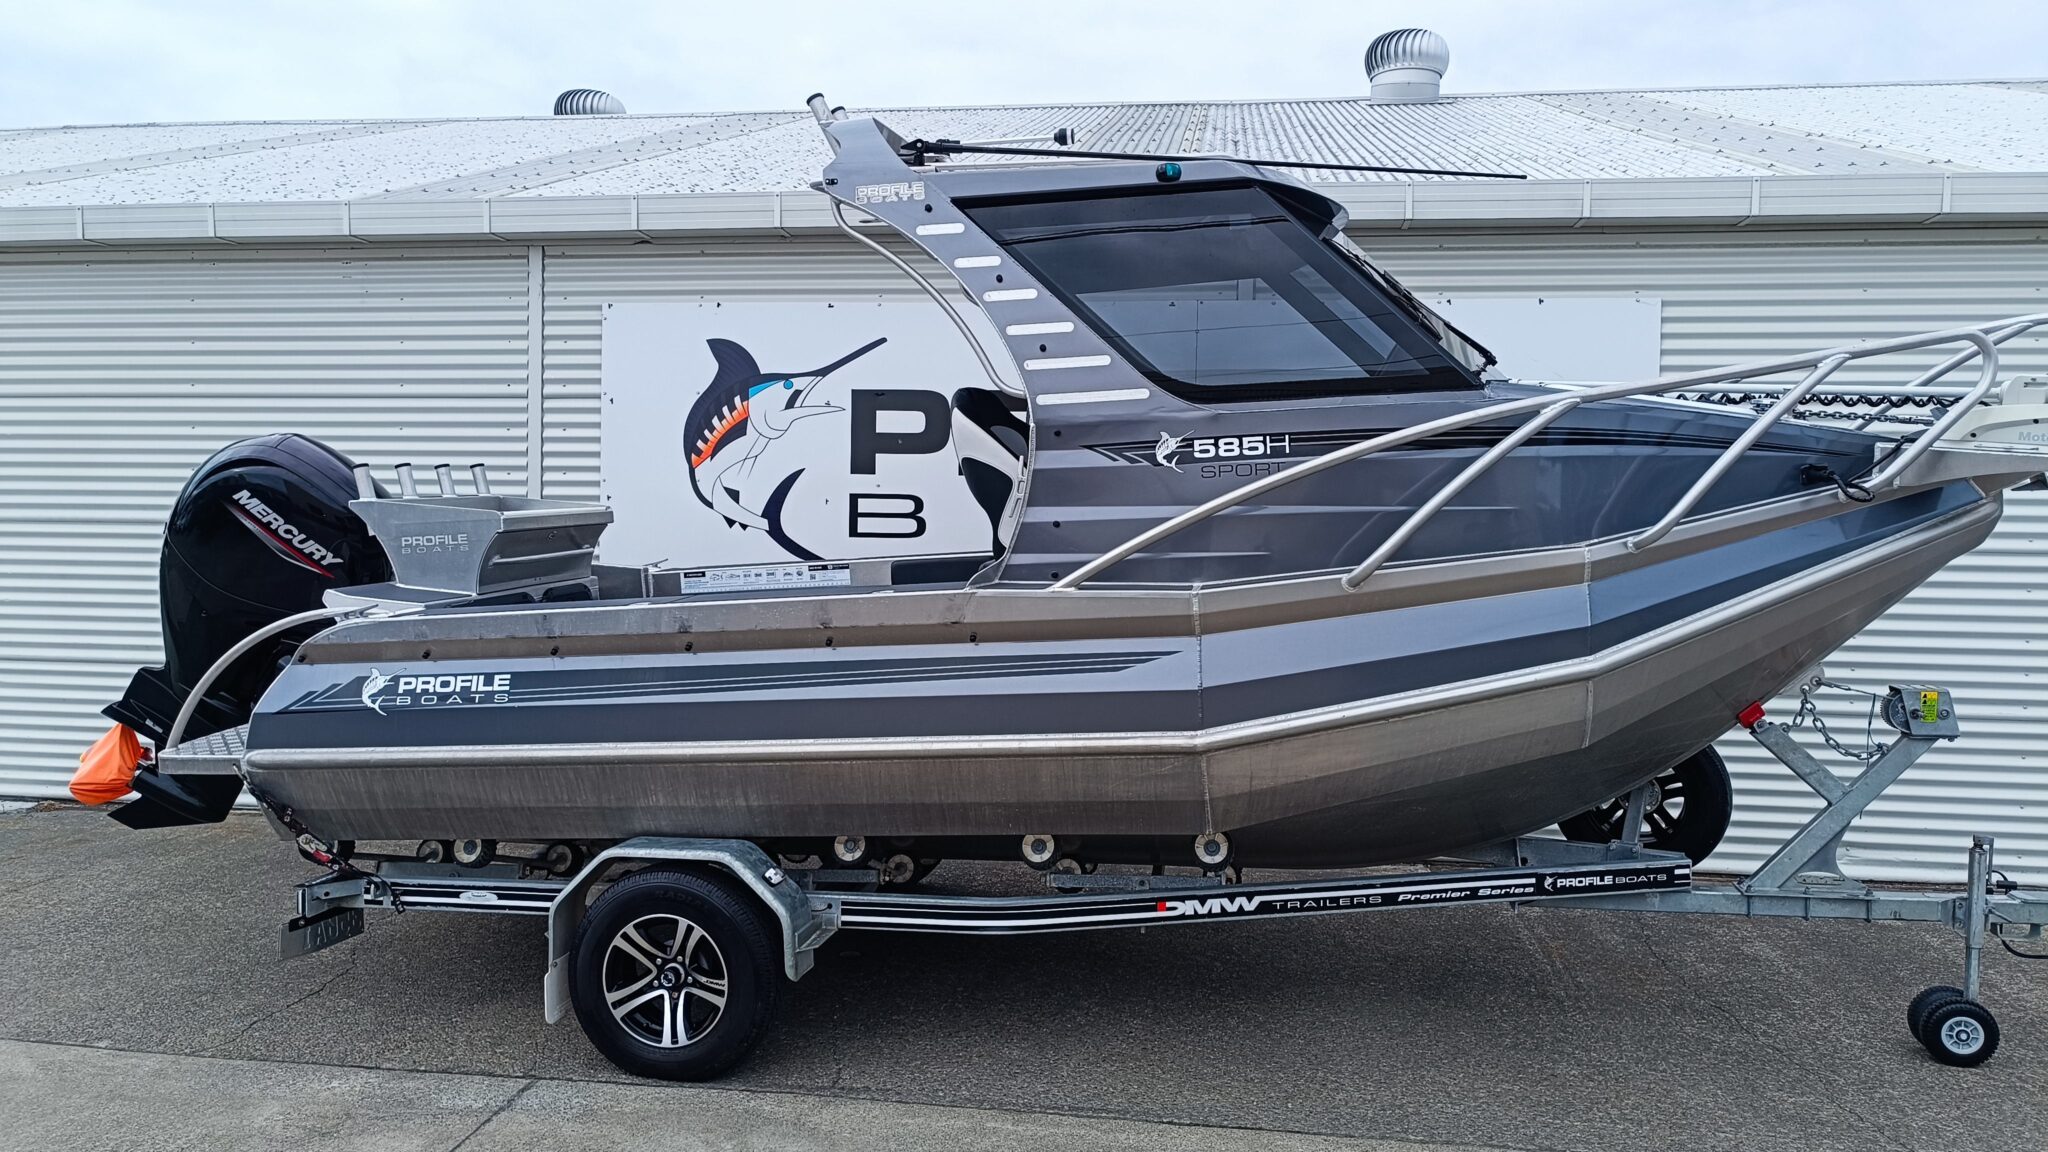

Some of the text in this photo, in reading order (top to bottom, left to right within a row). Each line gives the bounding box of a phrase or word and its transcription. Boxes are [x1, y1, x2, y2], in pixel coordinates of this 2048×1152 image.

[856, 181, 924, 197] PROFILE
[856, 191, 925, 204] BOATS
[1194, 435, 1289, 458] 585H
[1201, 462, 1286, 479] SPORT
[232, 490, 344, 566] MERCURY
[401, 534, 468, 547] PROFILE
[402, 545, 469, 554] BOATS
[398, 674, 511, 694] PROFILE
[396, 693, 509, 705] BOATS
[1557, 874, 1667, 888] PROFILE BOATS
[1157, 887, 1534, 917] DMW TRAILERS Premier Series
